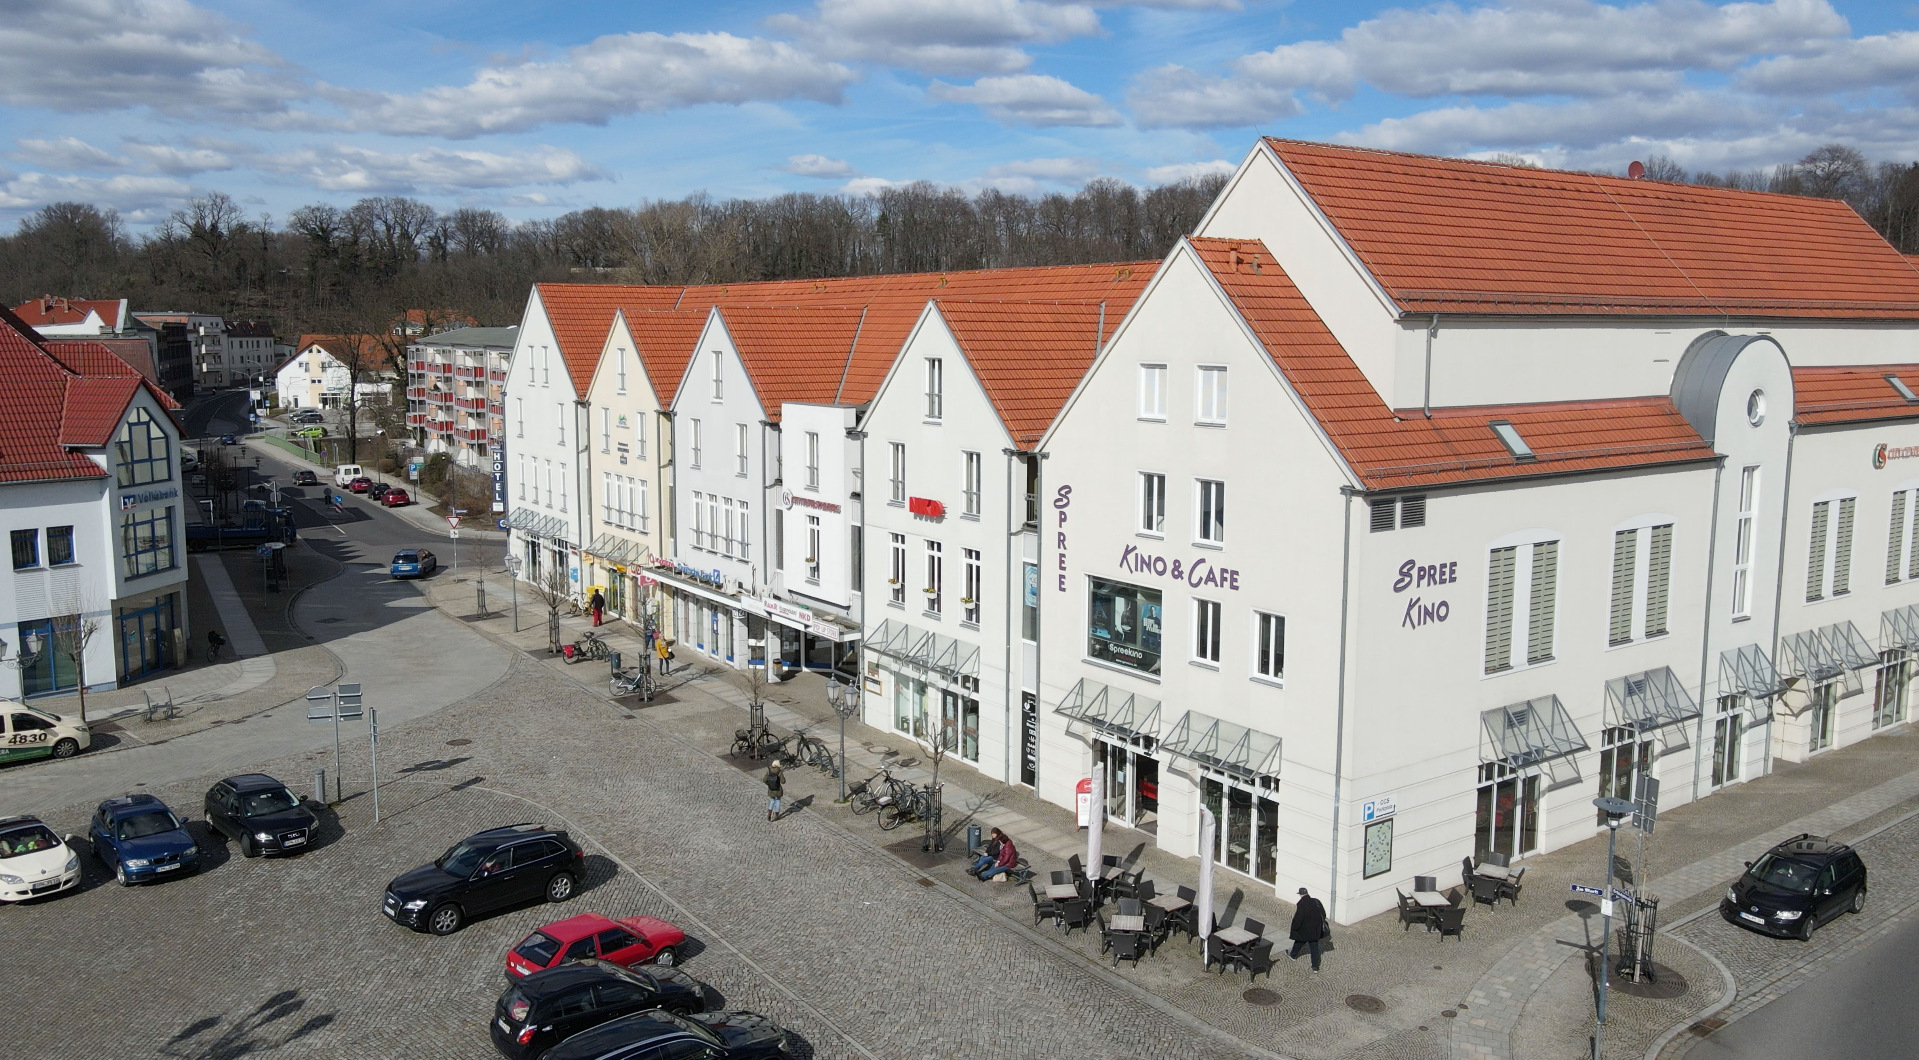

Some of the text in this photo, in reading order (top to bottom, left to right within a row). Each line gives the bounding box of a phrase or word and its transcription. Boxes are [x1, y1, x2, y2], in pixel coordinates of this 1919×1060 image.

[493, 452, 501, 501] HOTEL
[137, 488, 178, 503] Volksbank
[1053, 484, 1072, 592] SPREE
[1119, 544, 1240, 590] KINO & CAFE
[1393, 559, 1457, 593] SPREE
[799, 611, 811, 622] NKD
[1402, 596, 1449, 630] KINO
[1109, 643, 1142, 659] Spreekino
[8, 733, 47, 745] 4830
